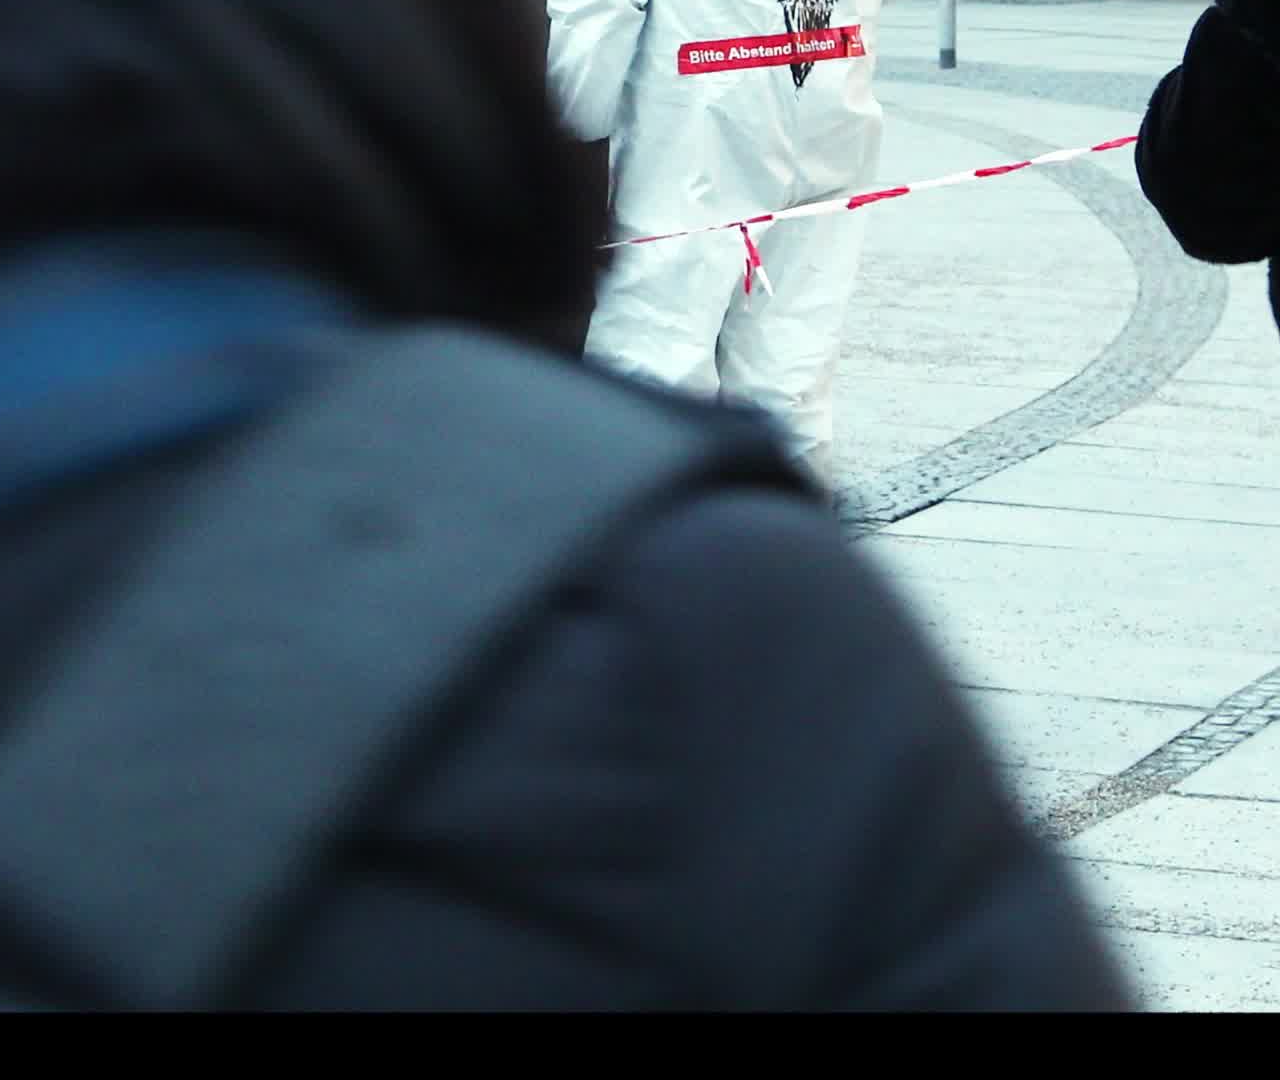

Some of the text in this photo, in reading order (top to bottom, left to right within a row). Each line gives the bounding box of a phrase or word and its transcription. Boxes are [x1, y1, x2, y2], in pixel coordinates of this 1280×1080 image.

[688, 38, 836, 64] Bitte Abstand halten
